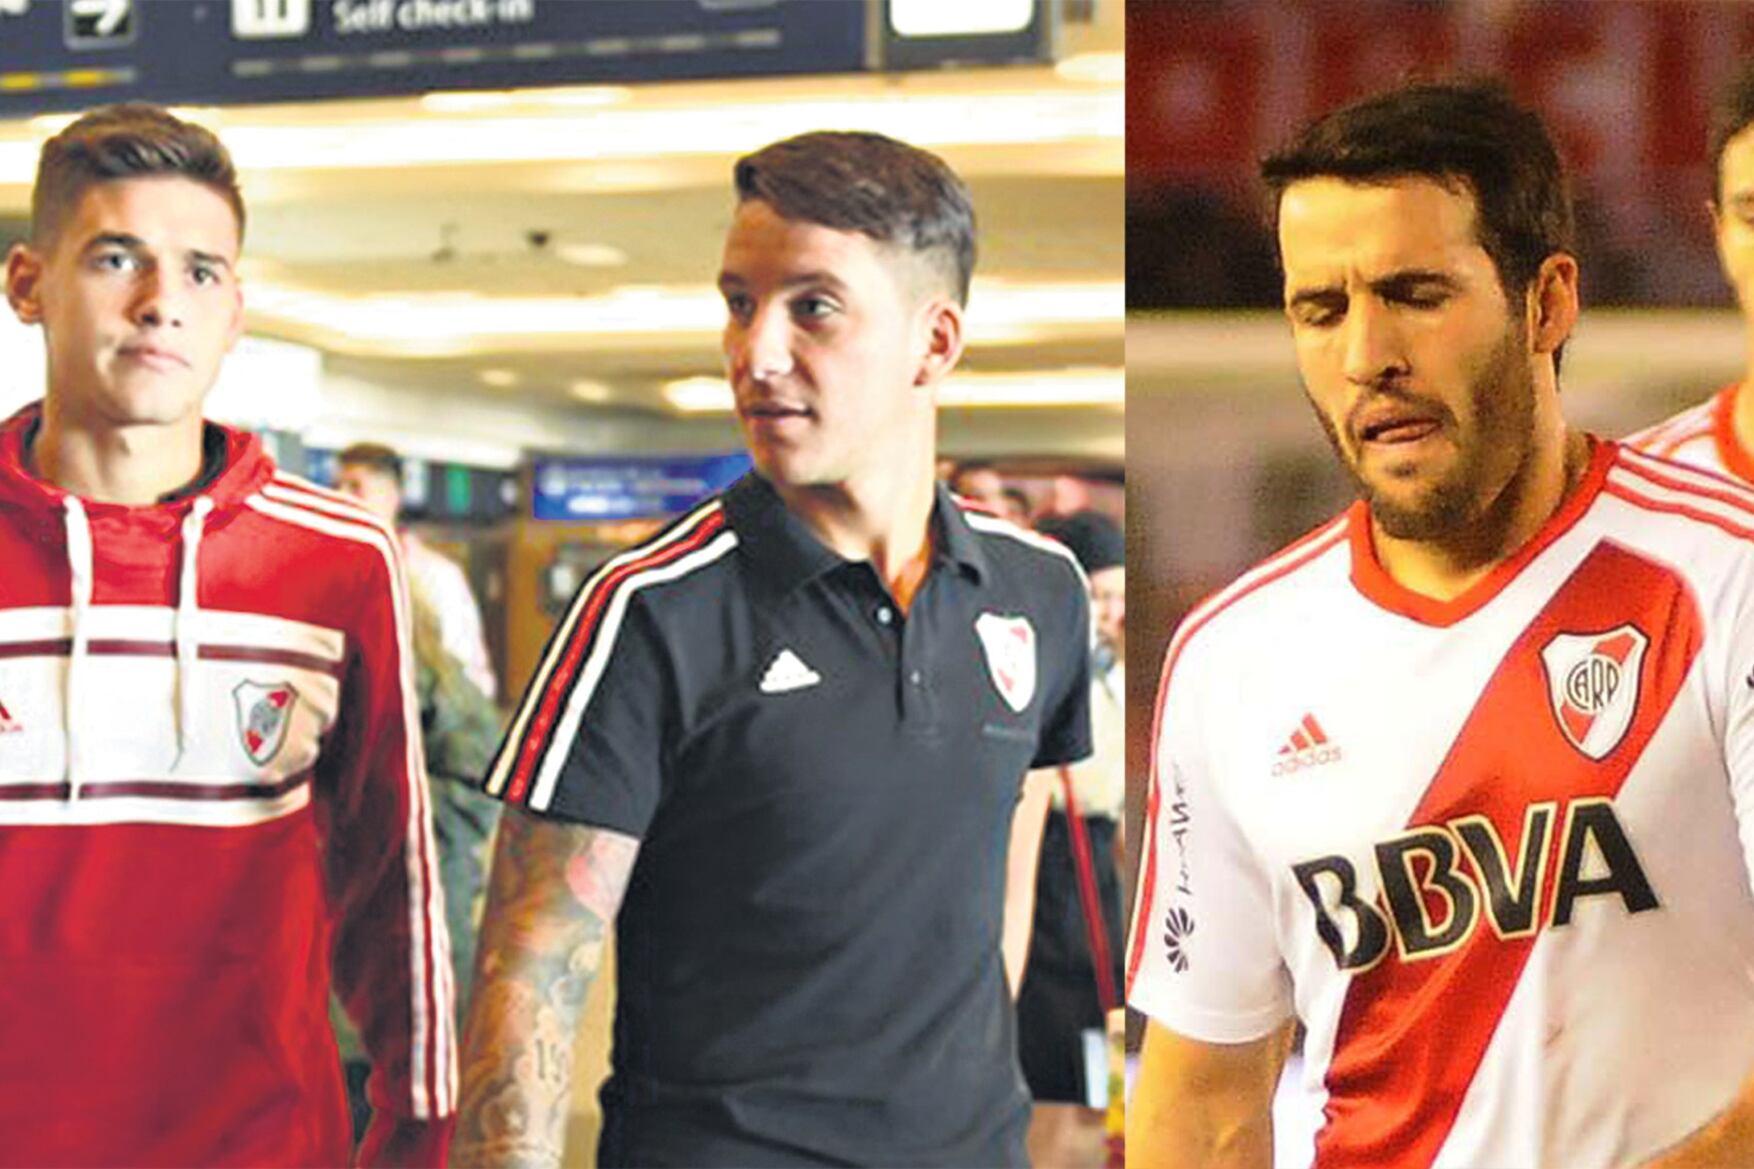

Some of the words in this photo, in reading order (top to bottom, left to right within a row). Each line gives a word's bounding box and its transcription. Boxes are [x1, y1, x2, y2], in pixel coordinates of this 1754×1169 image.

[333, 0, 393, 33] Self
[397, 0, 534, 29] check-in
[1291, 796, 1661, 973] BBVA
